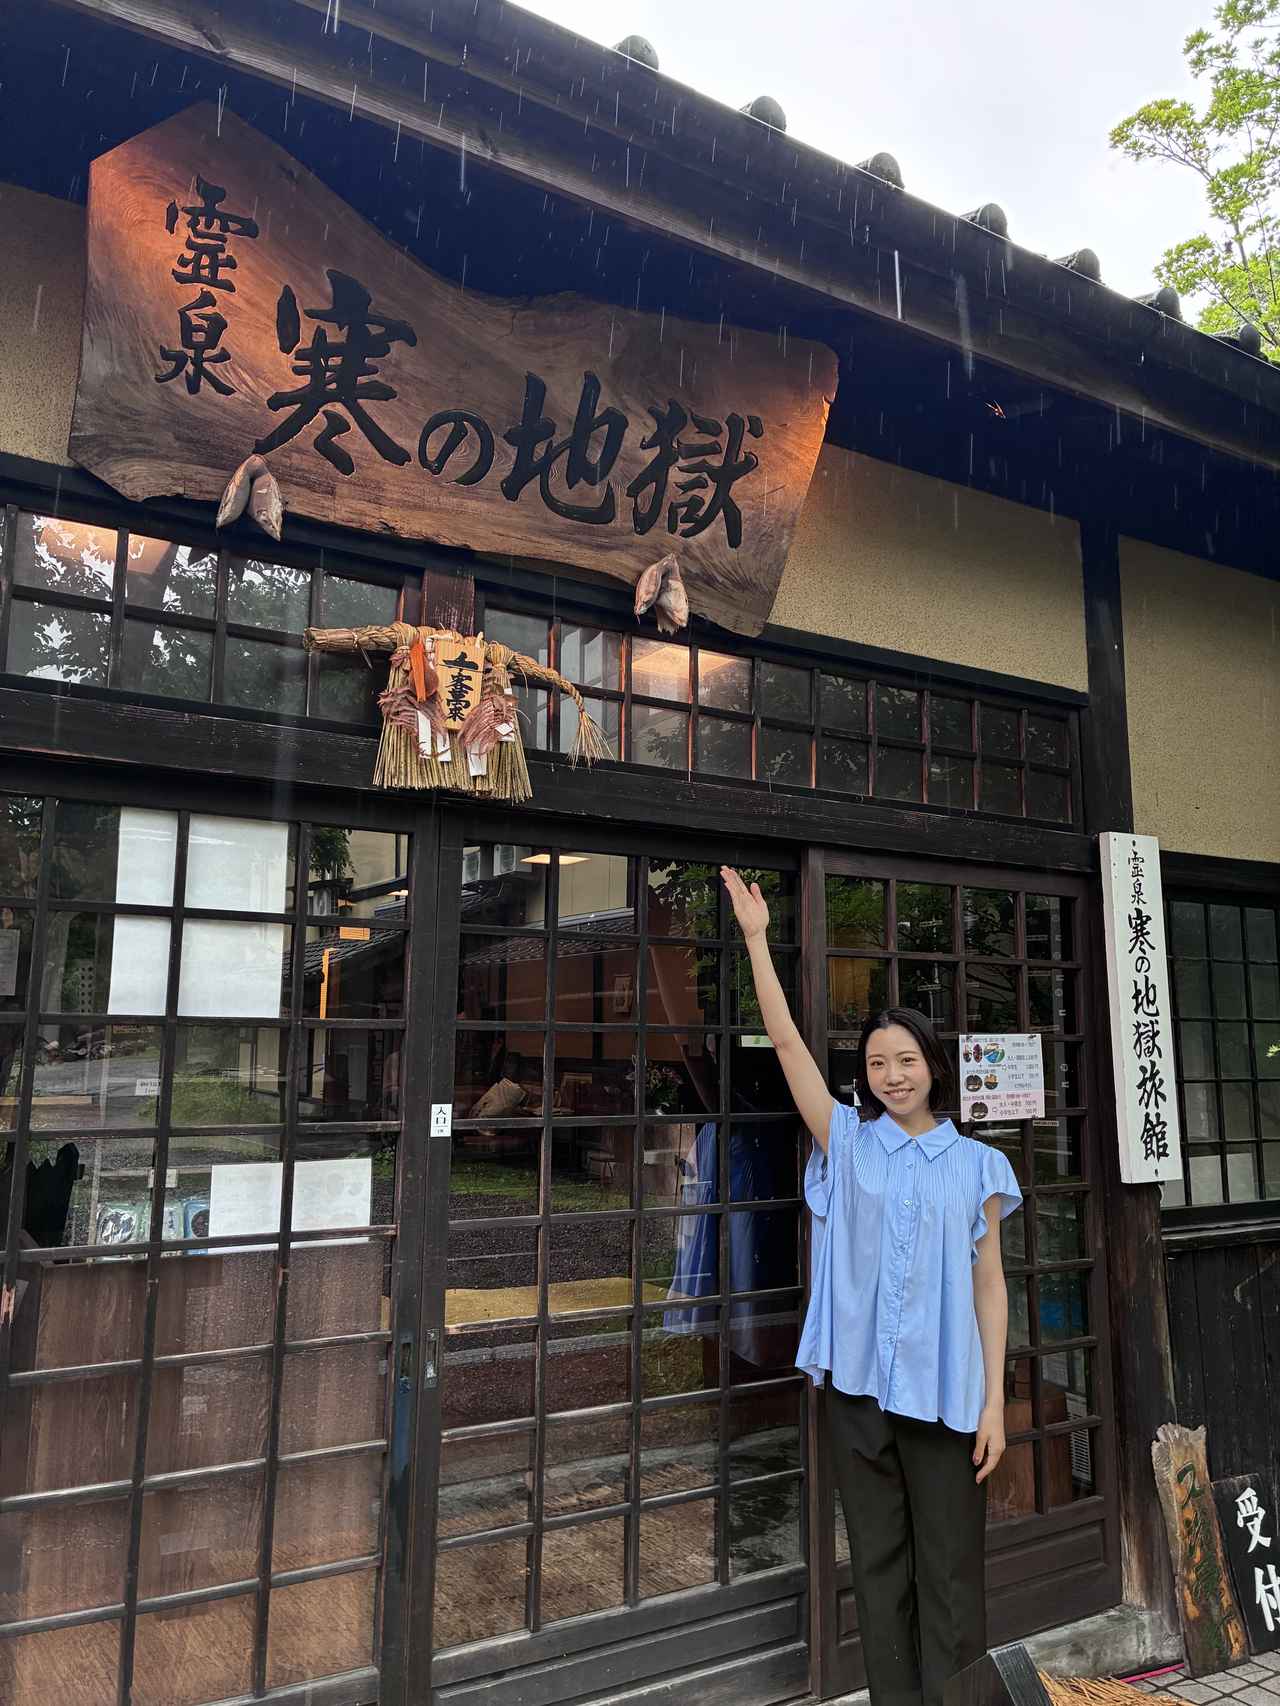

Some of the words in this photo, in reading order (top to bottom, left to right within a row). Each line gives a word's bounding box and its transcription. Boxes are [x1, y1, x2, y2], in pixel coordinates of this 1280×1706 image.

[155, 175, 259, 396] 霊泉
[254, 268, 764, 549] 寒の地獄
